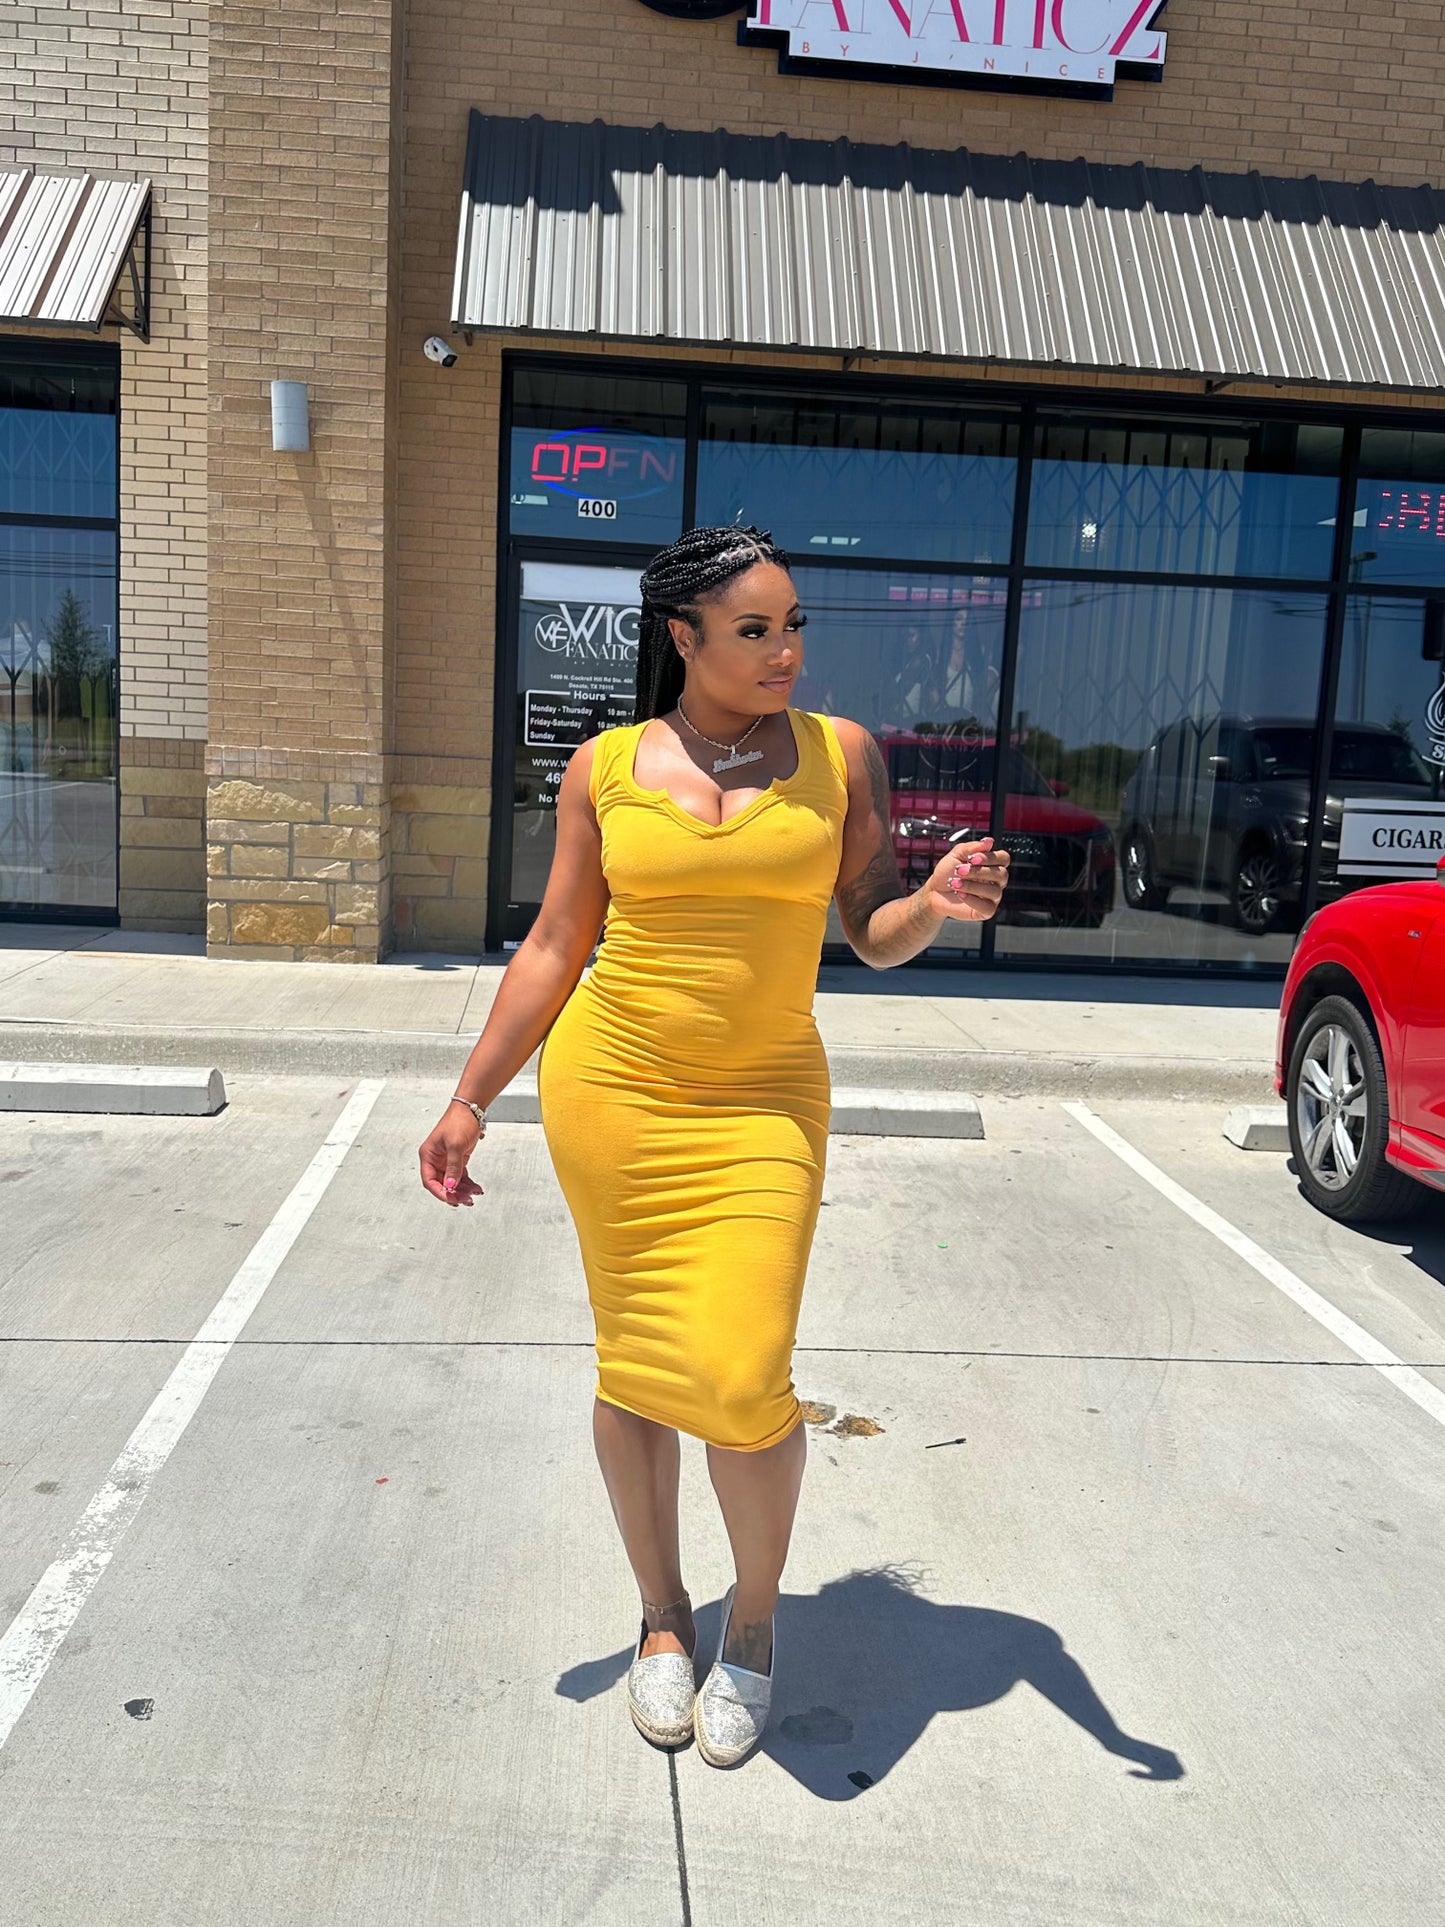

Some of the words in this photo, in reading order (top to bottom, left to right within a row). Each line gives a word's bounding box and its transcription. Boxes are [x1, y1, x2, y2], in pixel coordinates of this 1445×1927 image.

[802, 41, 850, 57] BY
[912, 51, 1106, 80] J'NICE
[579, 500, 616, 518] 400
[559, 603, 641, 646] WIG
[565, 641, 640, 662] FANATIC
[574, 690, 606, 701] Hours
[530, 704, 557, 714] Monday
[562, 705, 593, 716] Thursday
[608, 708, 615, 716] 10
[597, 721, 606, 729] 10
[530, 731, 555, 741] Sunday
[538, 793, 553, 803] No
[1372, 827, 1445, 850] CIGAR
